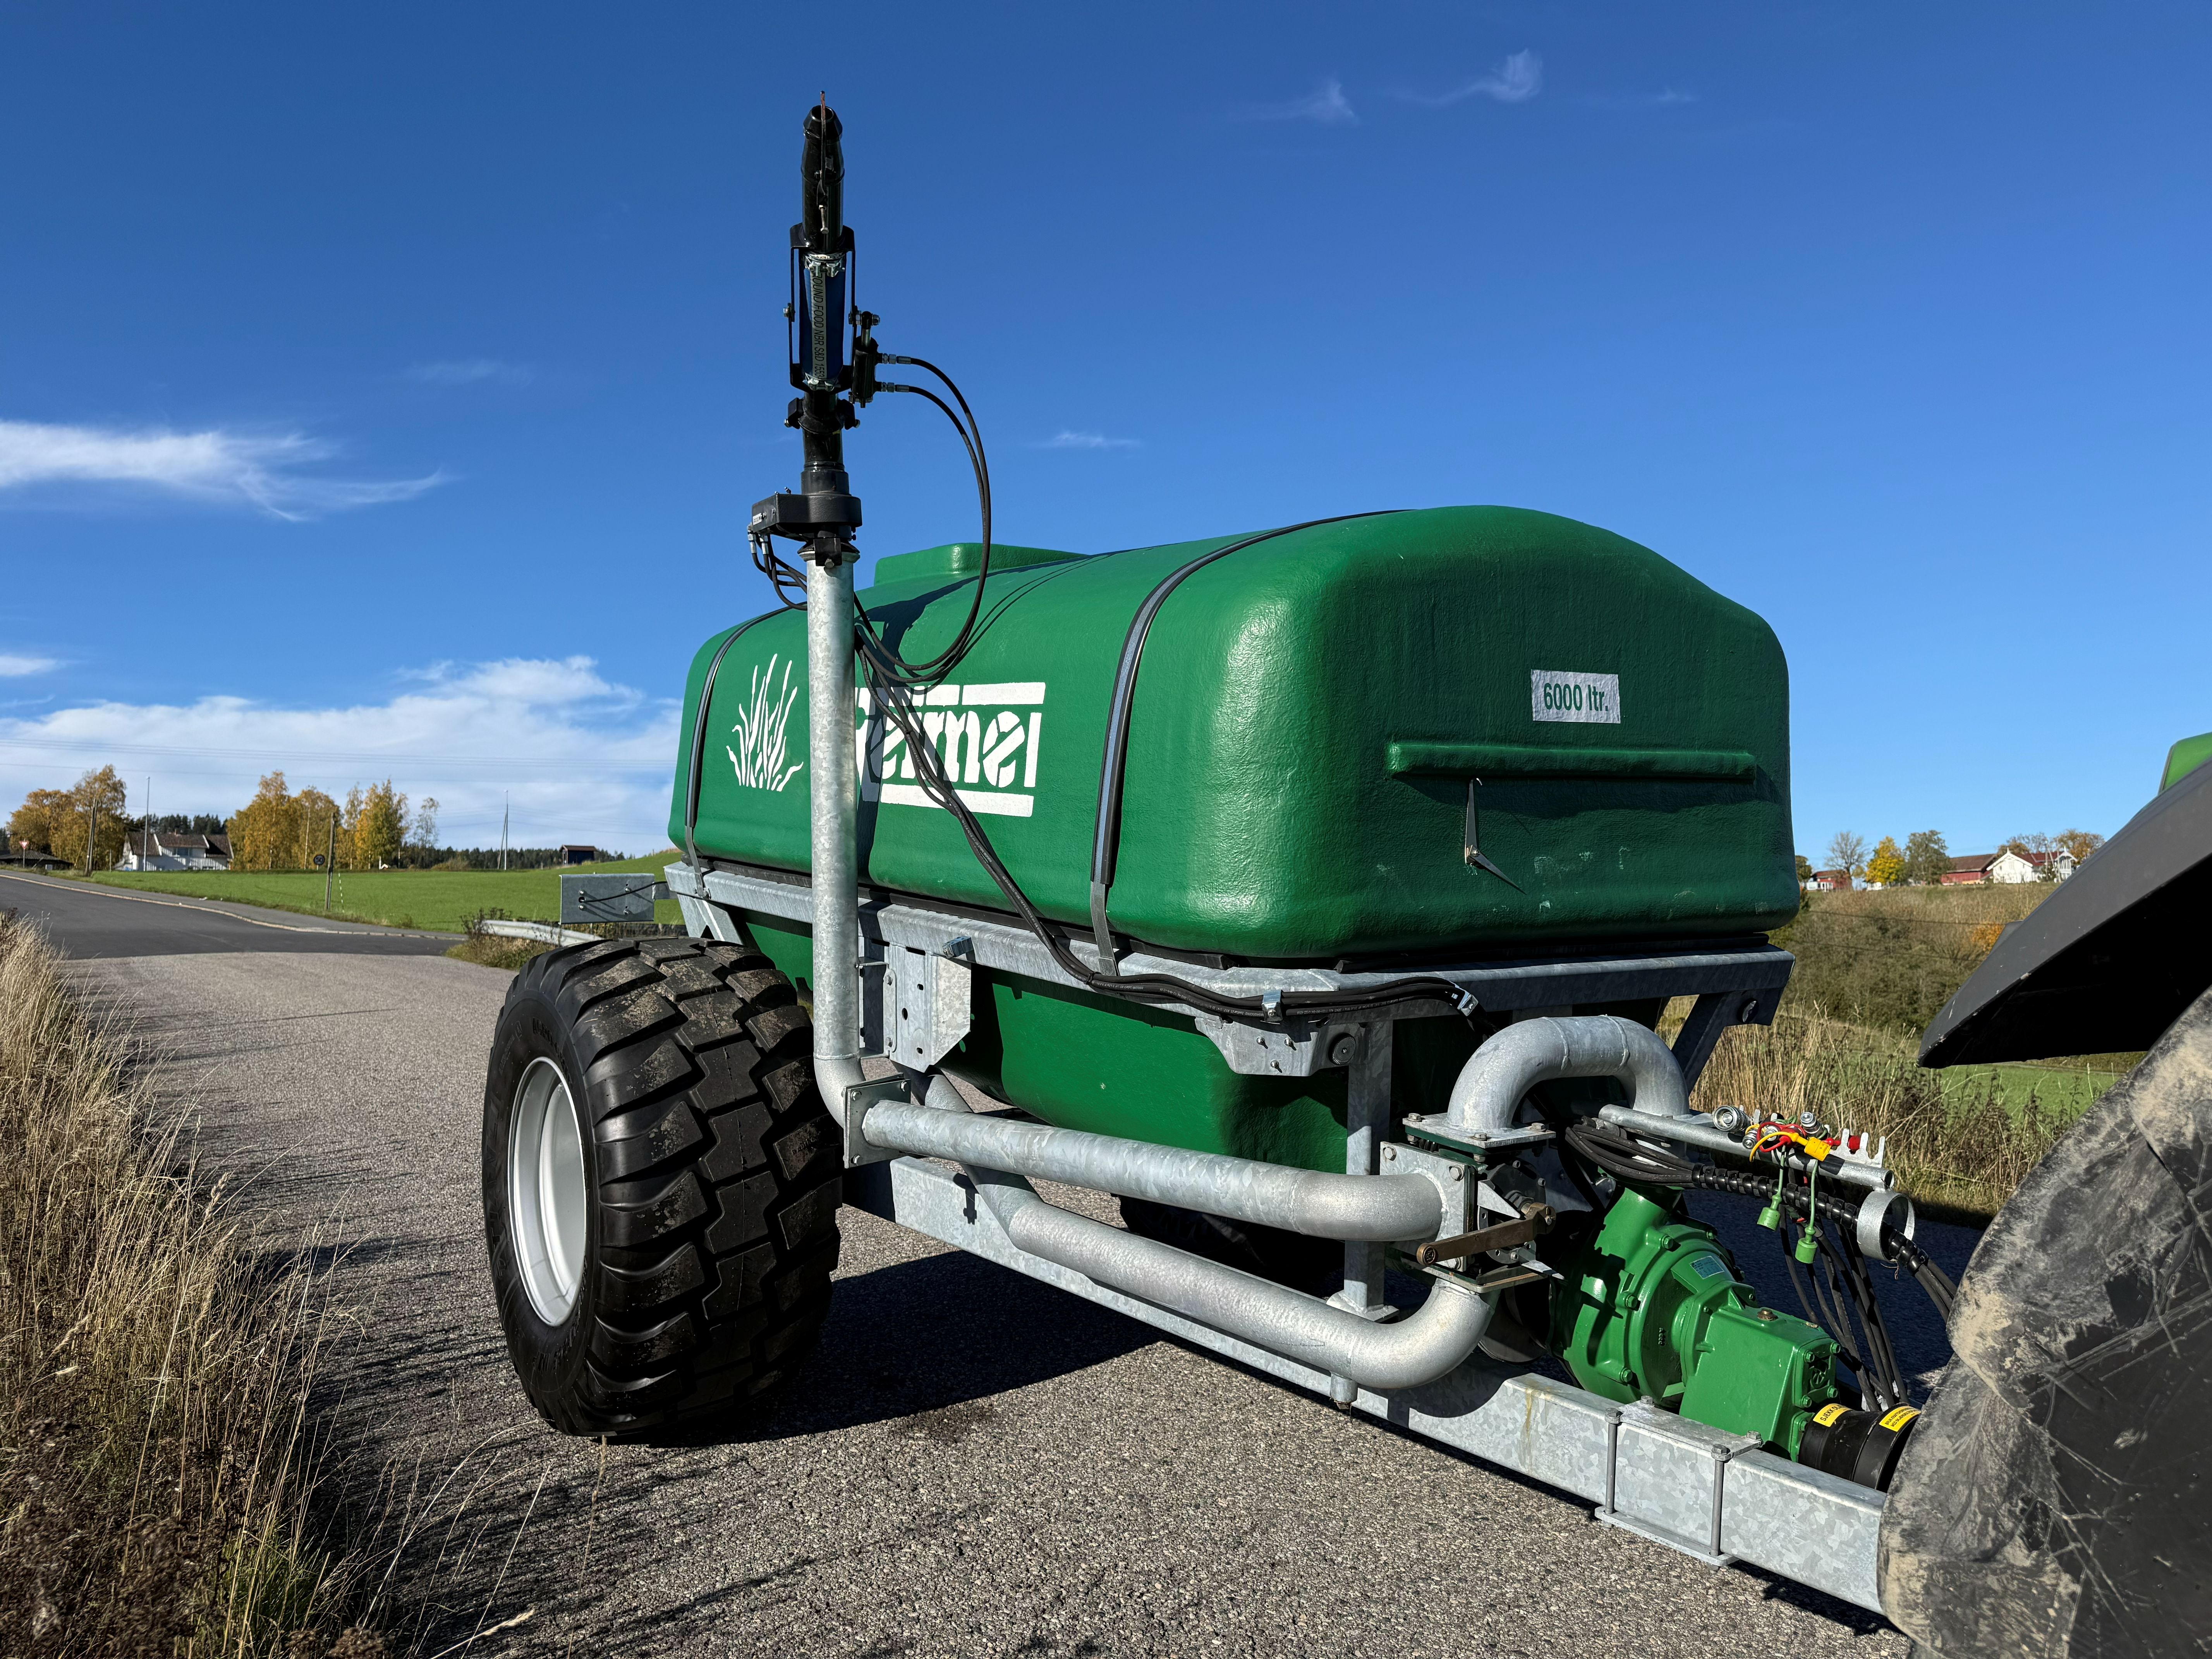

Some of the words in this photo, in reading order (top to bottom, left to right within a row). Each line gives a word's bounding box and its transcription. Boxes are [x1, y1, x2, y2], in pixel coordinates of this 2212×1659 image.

[813, 305, 824, 328] FOOD
[814, 330, 824, 346] NBR
[814, 347, 824, 362] S&D
[1544, 682, 1583, 711] 6000
[1587, 684, 1609, 711] ltr.
[1820, 1408, 1836, 1421] SJEKK
